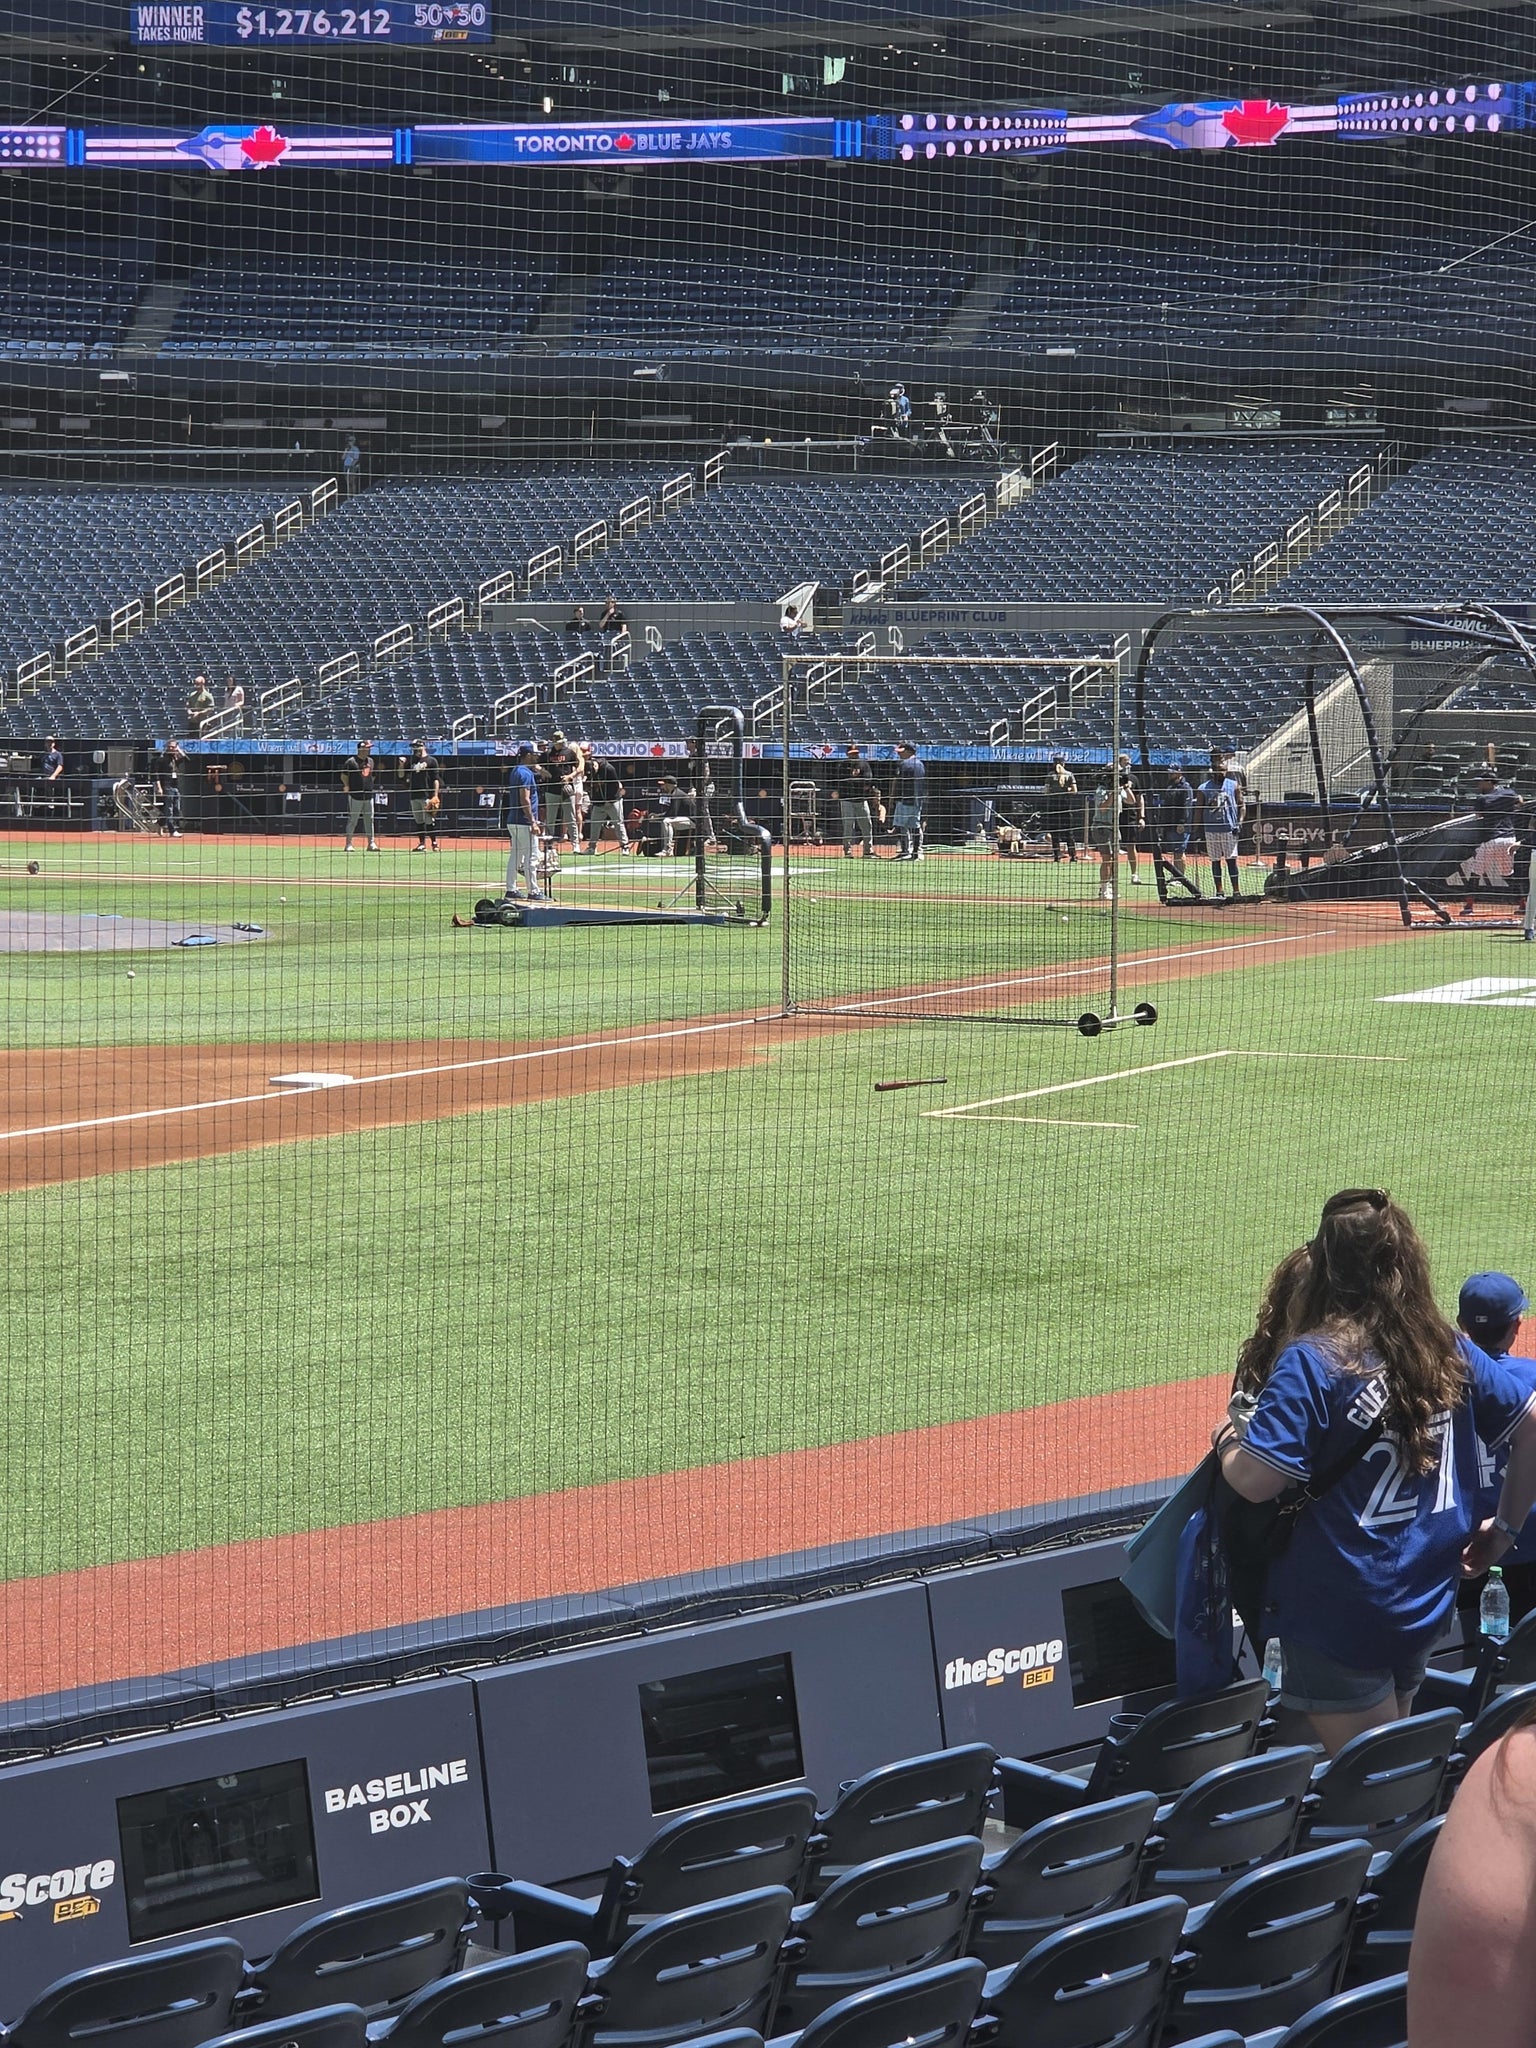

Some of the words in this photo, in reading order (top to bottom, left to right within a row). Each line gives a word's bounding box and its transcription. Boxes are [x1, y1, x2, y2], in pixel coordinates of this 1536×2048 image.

[138, 6, 204, 26] WINNER
[236, 7, 391, 38] $1,276,212
[414, 4, 443, 26] 50
[457, 3, 486, 26] 50
[137, 27, 170, 41] TAKES
[173, 27, 204, 41] HOME
[514, 135, 613, 153] TORONTO
[637, 133, 682, 151] BLUE
[686, 131, 732, 150] JAYS
[850, 609, 888, 625] KPMG
[895, 610, 967, 622] BLUEPRINT
[972, 611, 1007, 622] CLUB
[588, 742, 647, 756] ORONTO
[1346, 1370, 1391, 1430] GUE
[1359, 1409, 1458, 1526] 27
[945, 1639, 1063, 1690] theScore
[1025, 1669, 1052, 1686] BET
[324, 1759, 469, 1814] BASELINE
[369, 1798, 432, 1834] BOX
